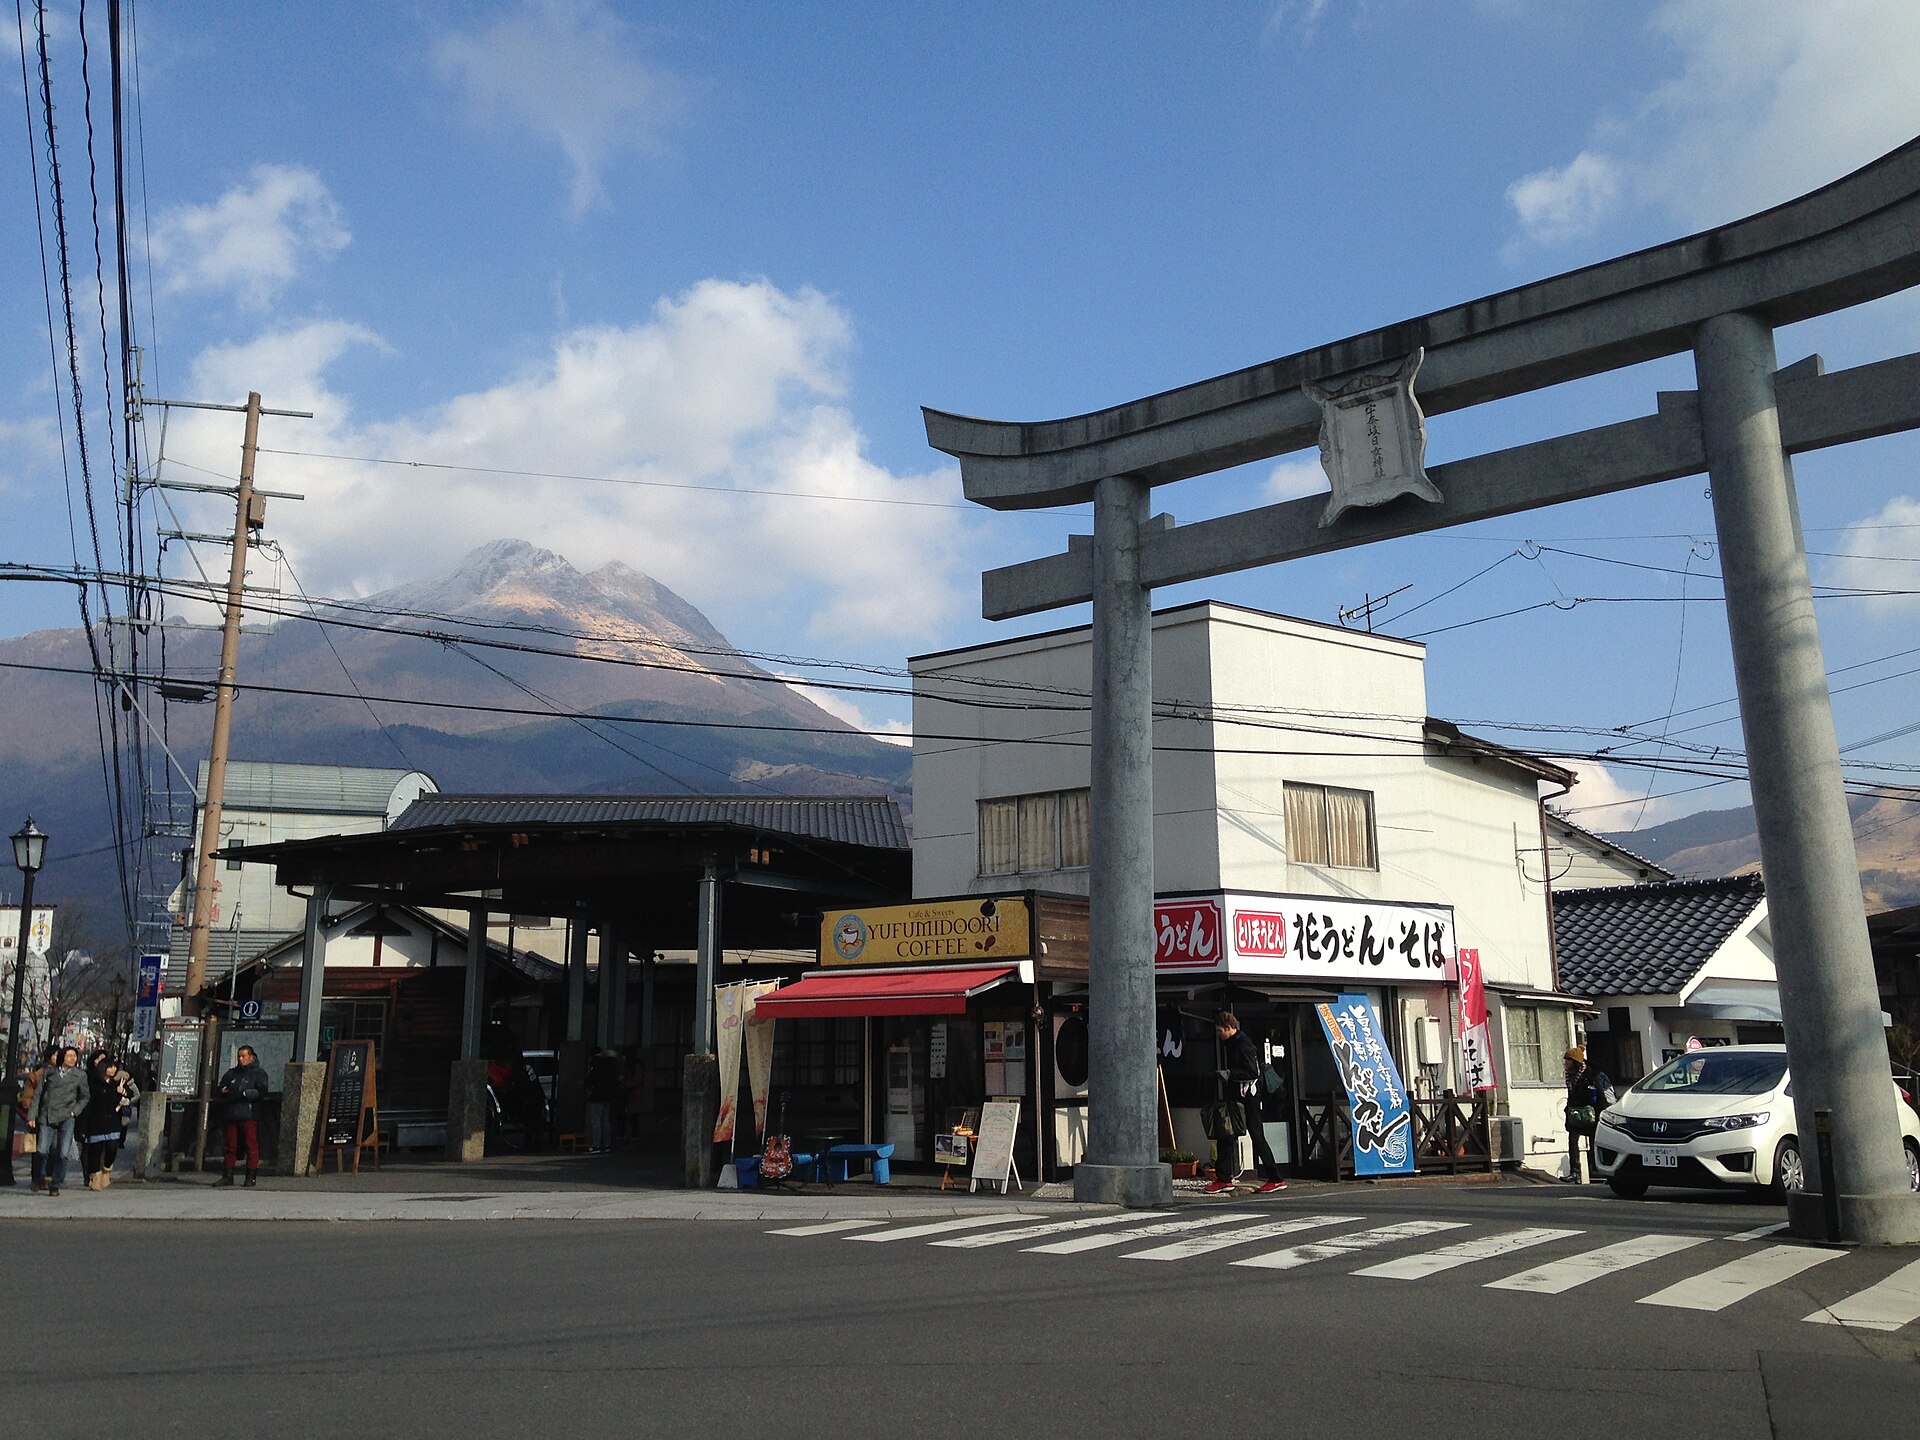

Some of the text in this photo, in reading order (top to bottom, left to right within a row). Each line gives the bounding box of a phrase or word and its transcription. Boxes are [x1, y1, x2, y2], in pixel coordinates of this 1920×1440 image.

[1364, 404, 1386, 478] 宇奈岐日女神社
[867, 915, 1001, 940] YUFUMIDOORI
[908, 909, 955, 919] Cafe & Sweets
[896, 938, 967, 958] COFFEE
[1154, 911, 1214, 958] うどん
[1237, 917, 1284, 951] とり天うどん
[1464, 1038, 1486, 1088] そば
